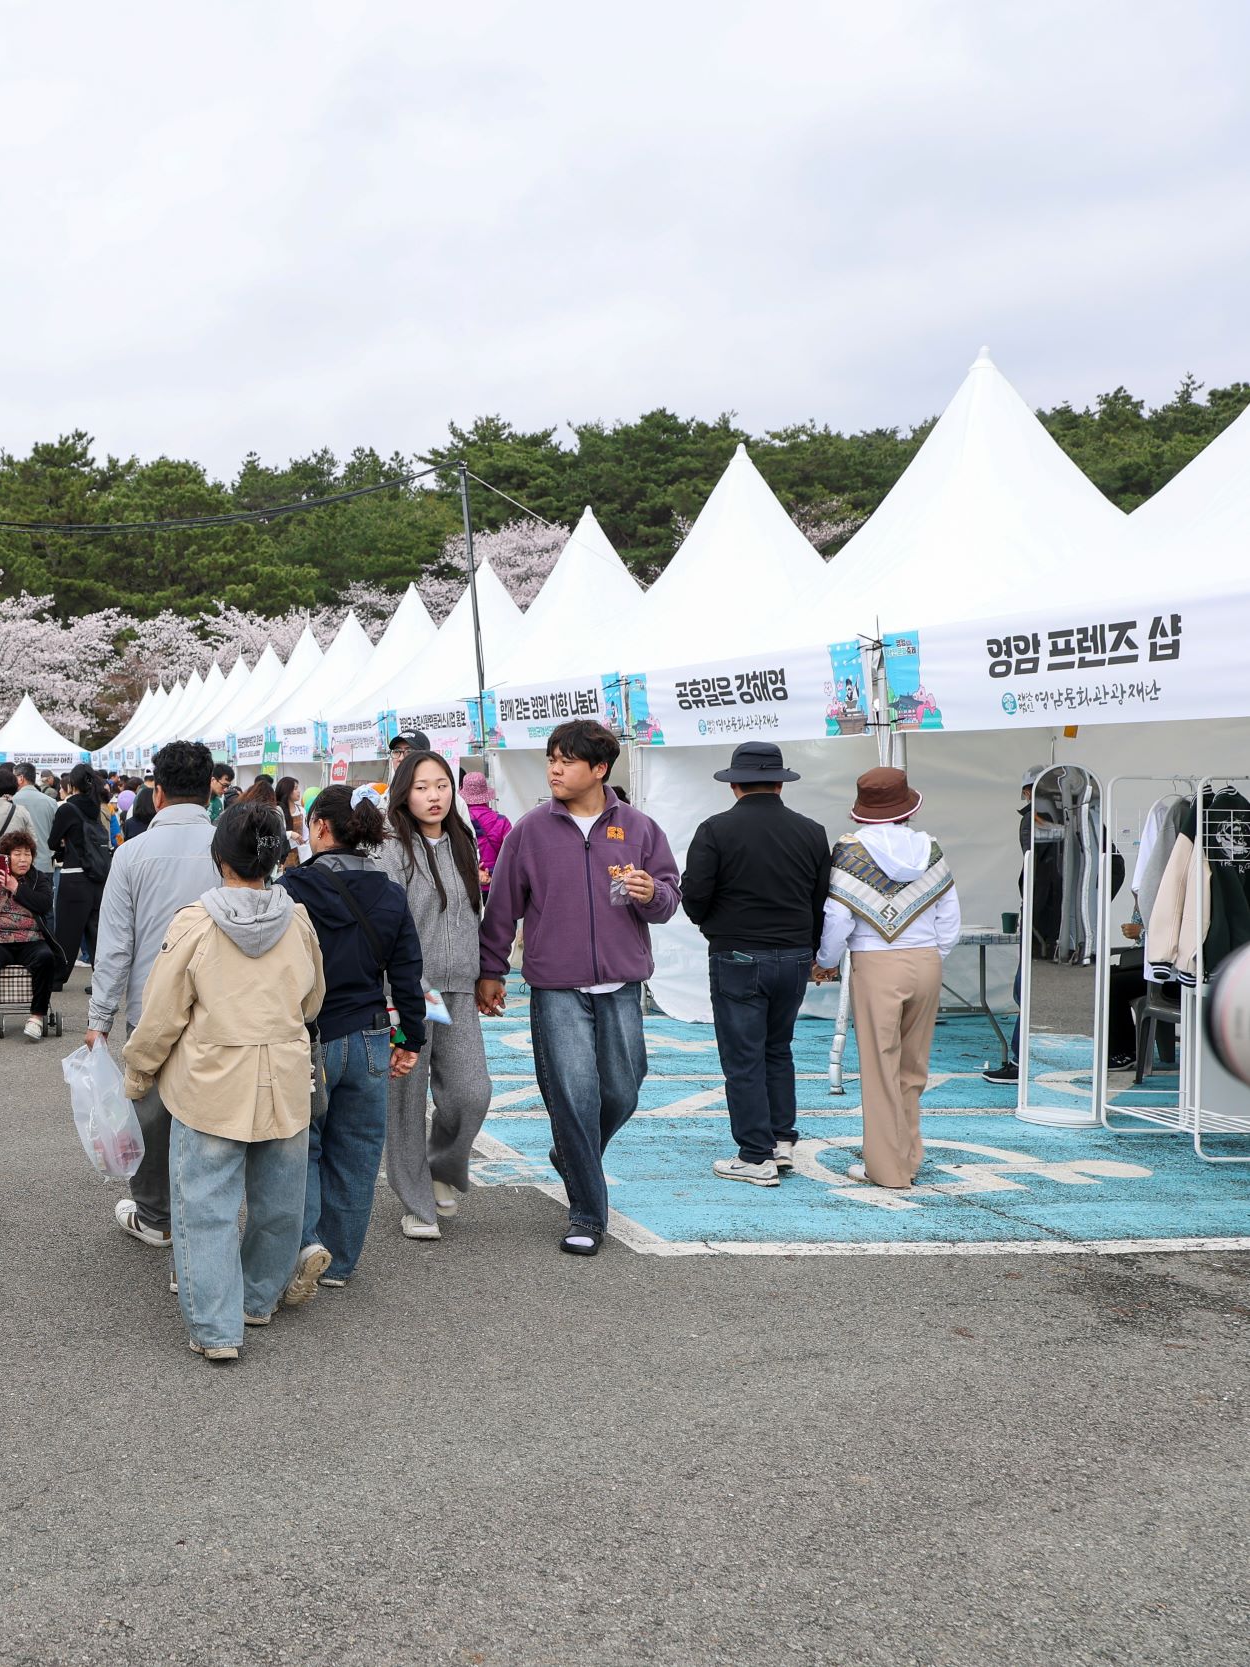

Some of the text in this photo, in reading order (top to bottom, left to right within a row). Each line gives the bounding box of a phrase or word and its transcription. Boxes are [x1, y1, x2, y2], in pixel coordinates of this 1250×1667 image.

[986, 614, 1182, 679] 영암 프렌즈 샵
[499, 698, 515, 722] 함께
[515, 697, 531, 721] 걷는
[568, 688, 600, 715] 나눔터
[674, 668, 789, 710] 공휴일은 강해영
[456, 710, 467, 728] 홍보
